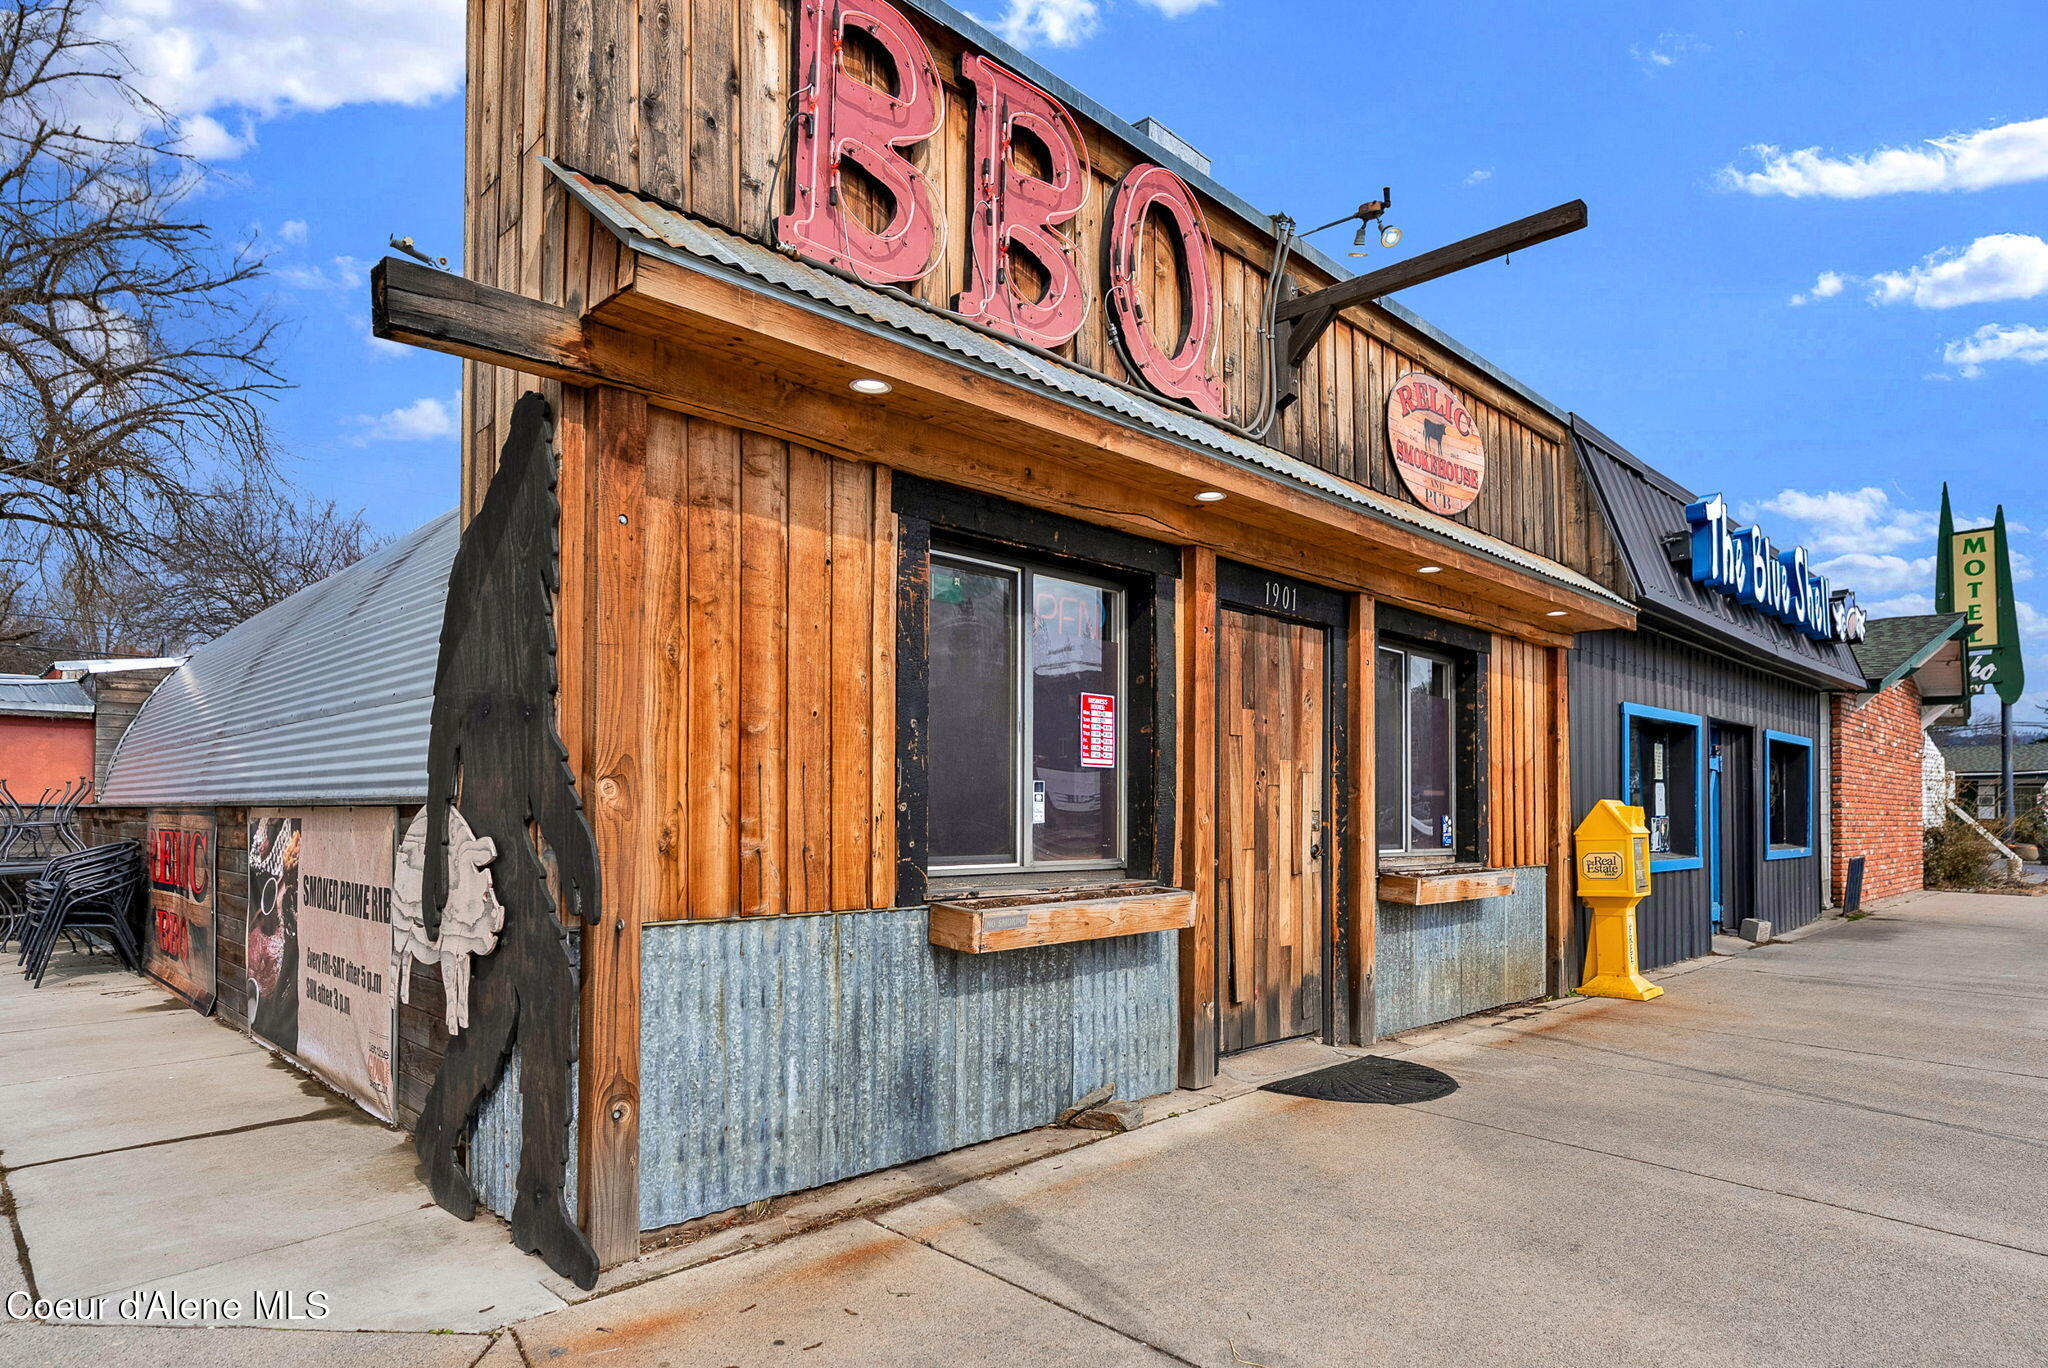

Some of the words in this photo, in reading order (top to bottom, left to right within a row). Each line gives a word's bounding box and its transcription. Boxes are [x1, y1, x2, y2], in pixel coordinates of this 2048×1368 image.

[778, 0, 1231, 419] BBQ
[1396, 382, 1472, 437] RELIC
[1396, 439, 1479, 489] SMOKEHOUSE
[1430, 480, 1445, 491] AND
[1425, 488, 1452, 510] PUB
[1704, 492, 1746, 593] The
[1751, 524, 1790, 615] Blue
[1794, 545, 1832, 638] Shell
[1265, 581, 1297, 611] 1901
[1961, 536, 1987, 643] MOTEL
[1587, 864, 1618, 874] Estate
[1593, 856, 1616, 866] Real
[303, 874, 339, 913] SMOKED
[339, 881, 370, 920] PRIME
[371, 886, 391, 924] RIB
[157, 909, 192, 979] BBQ
[306, 947, 321, 973] Every
[322, 952, 345, 980] FRI-SAT
[346, 961, 360, 986] after
[361, 965, 366, 989] 5
[306, 977, 317, 1001] SUN
[318, 984, 333, 1007] after
[333, 988, 339, 1011] 3
